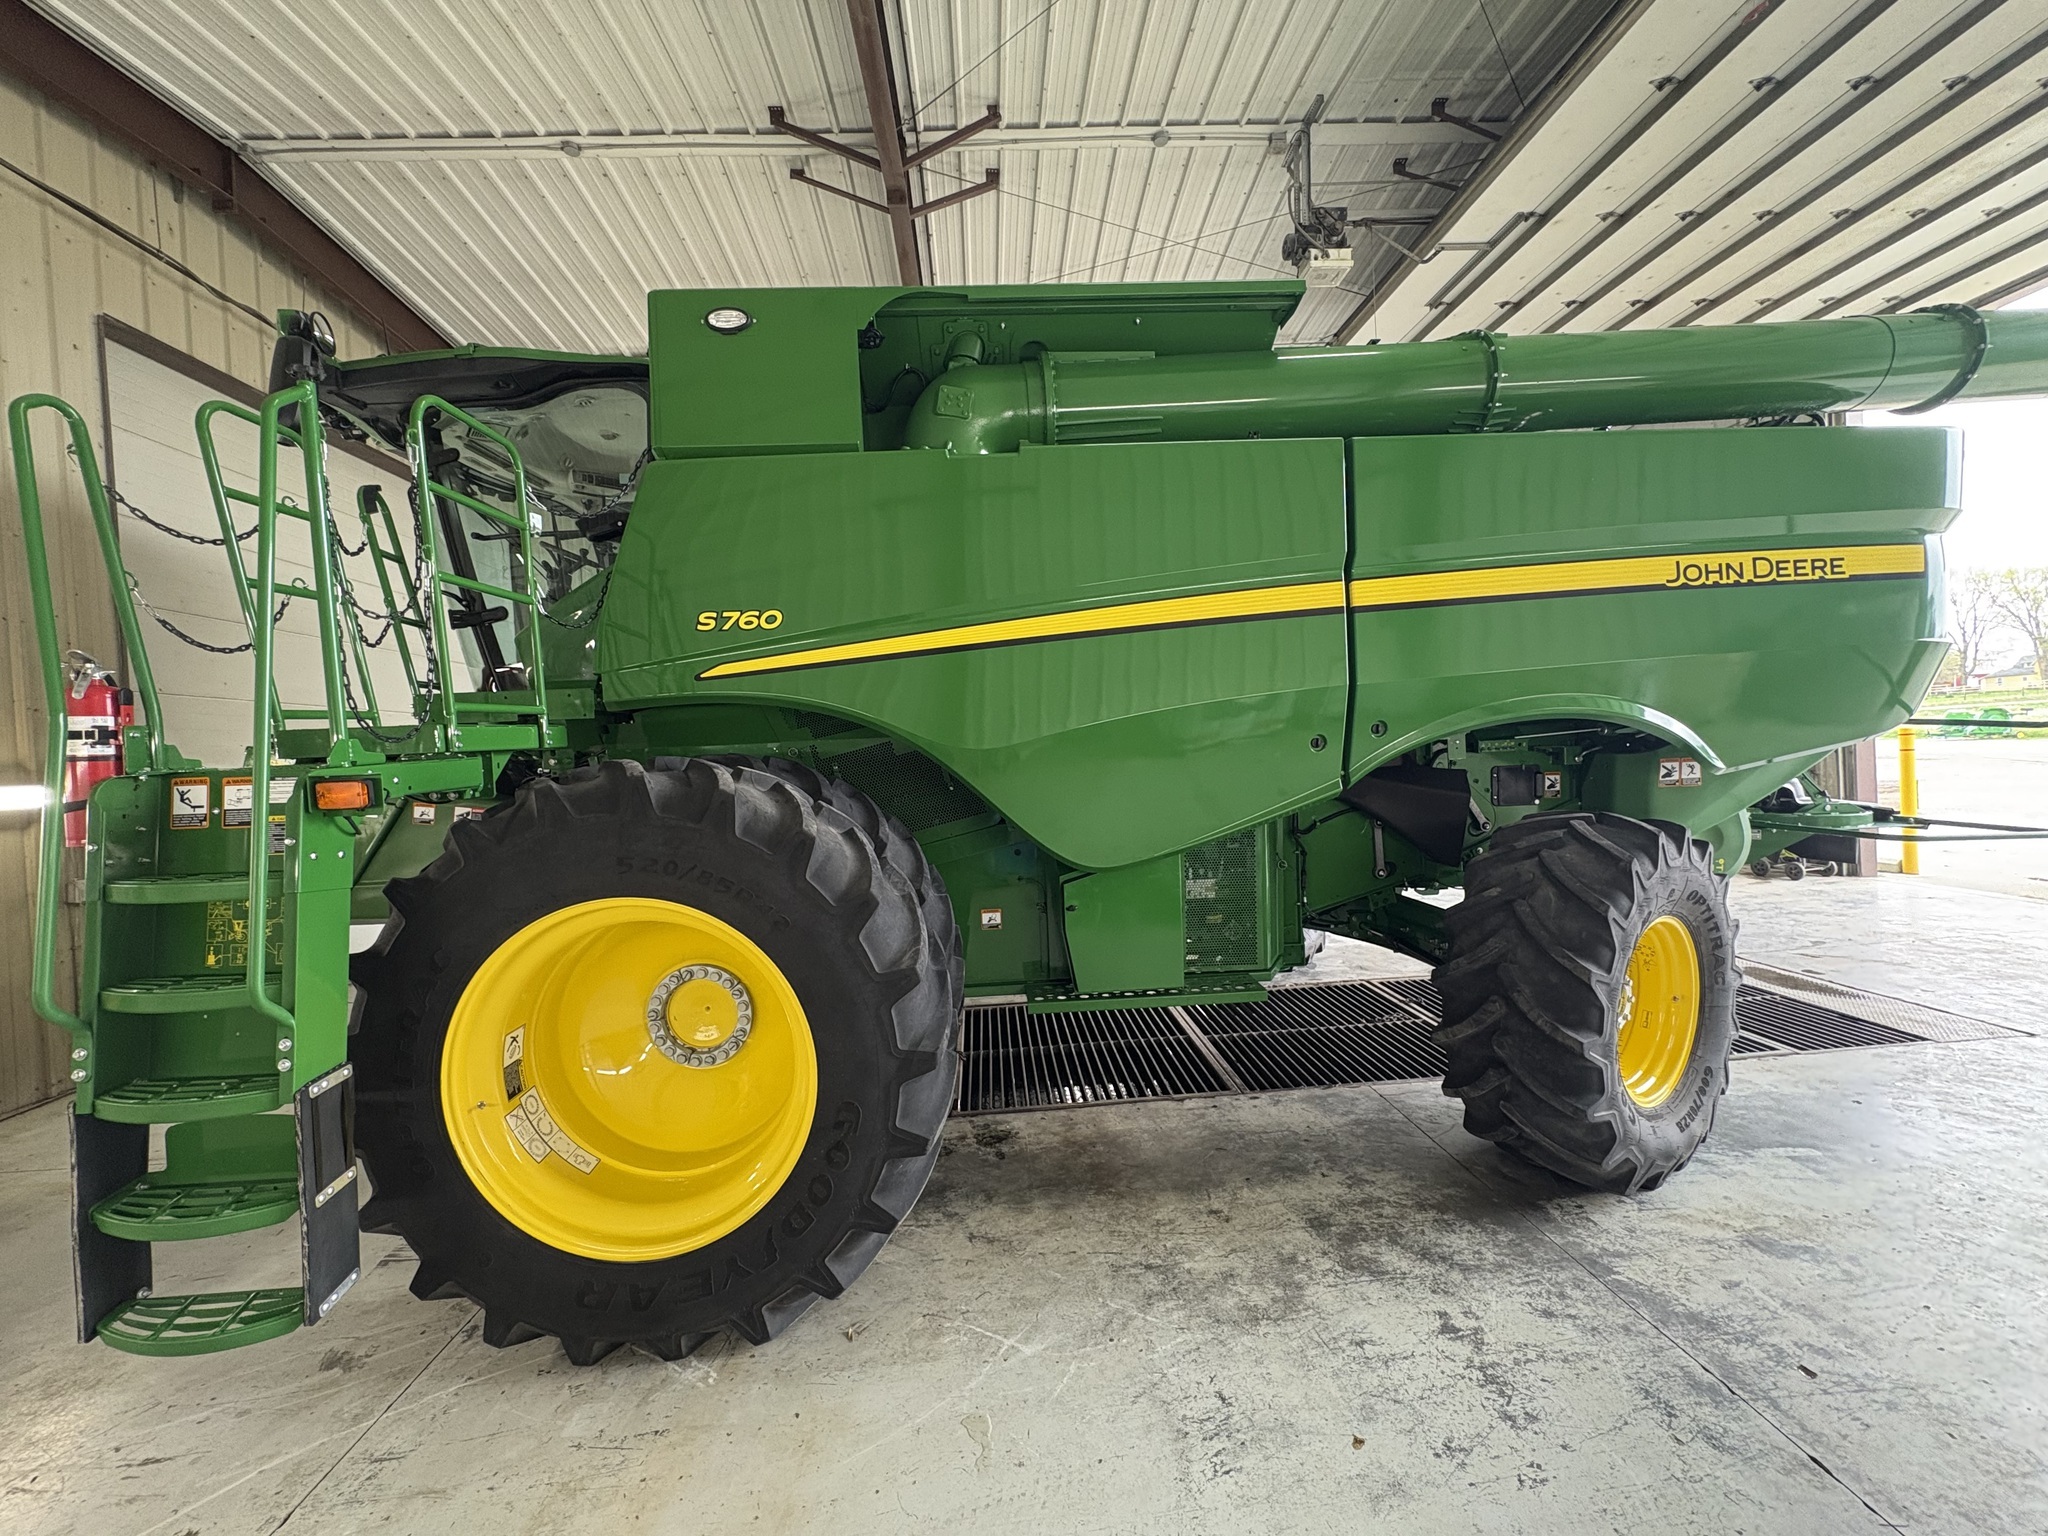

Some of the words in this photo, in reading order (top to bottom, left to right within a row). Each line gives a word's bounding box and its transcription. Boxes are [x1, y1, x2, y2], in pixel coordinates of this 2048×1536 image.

[1666, 560, 1745, 584] JOHN
[1752, 557, 1846, 579] DEERE
[695, 609, 784, 632] S760
[1686, 889, 1726, 986] OPTITRAC
[1675, 1065, 1713, 1133] 600/70R28
[575, 1101, 862, 1312] GOODYEAR
